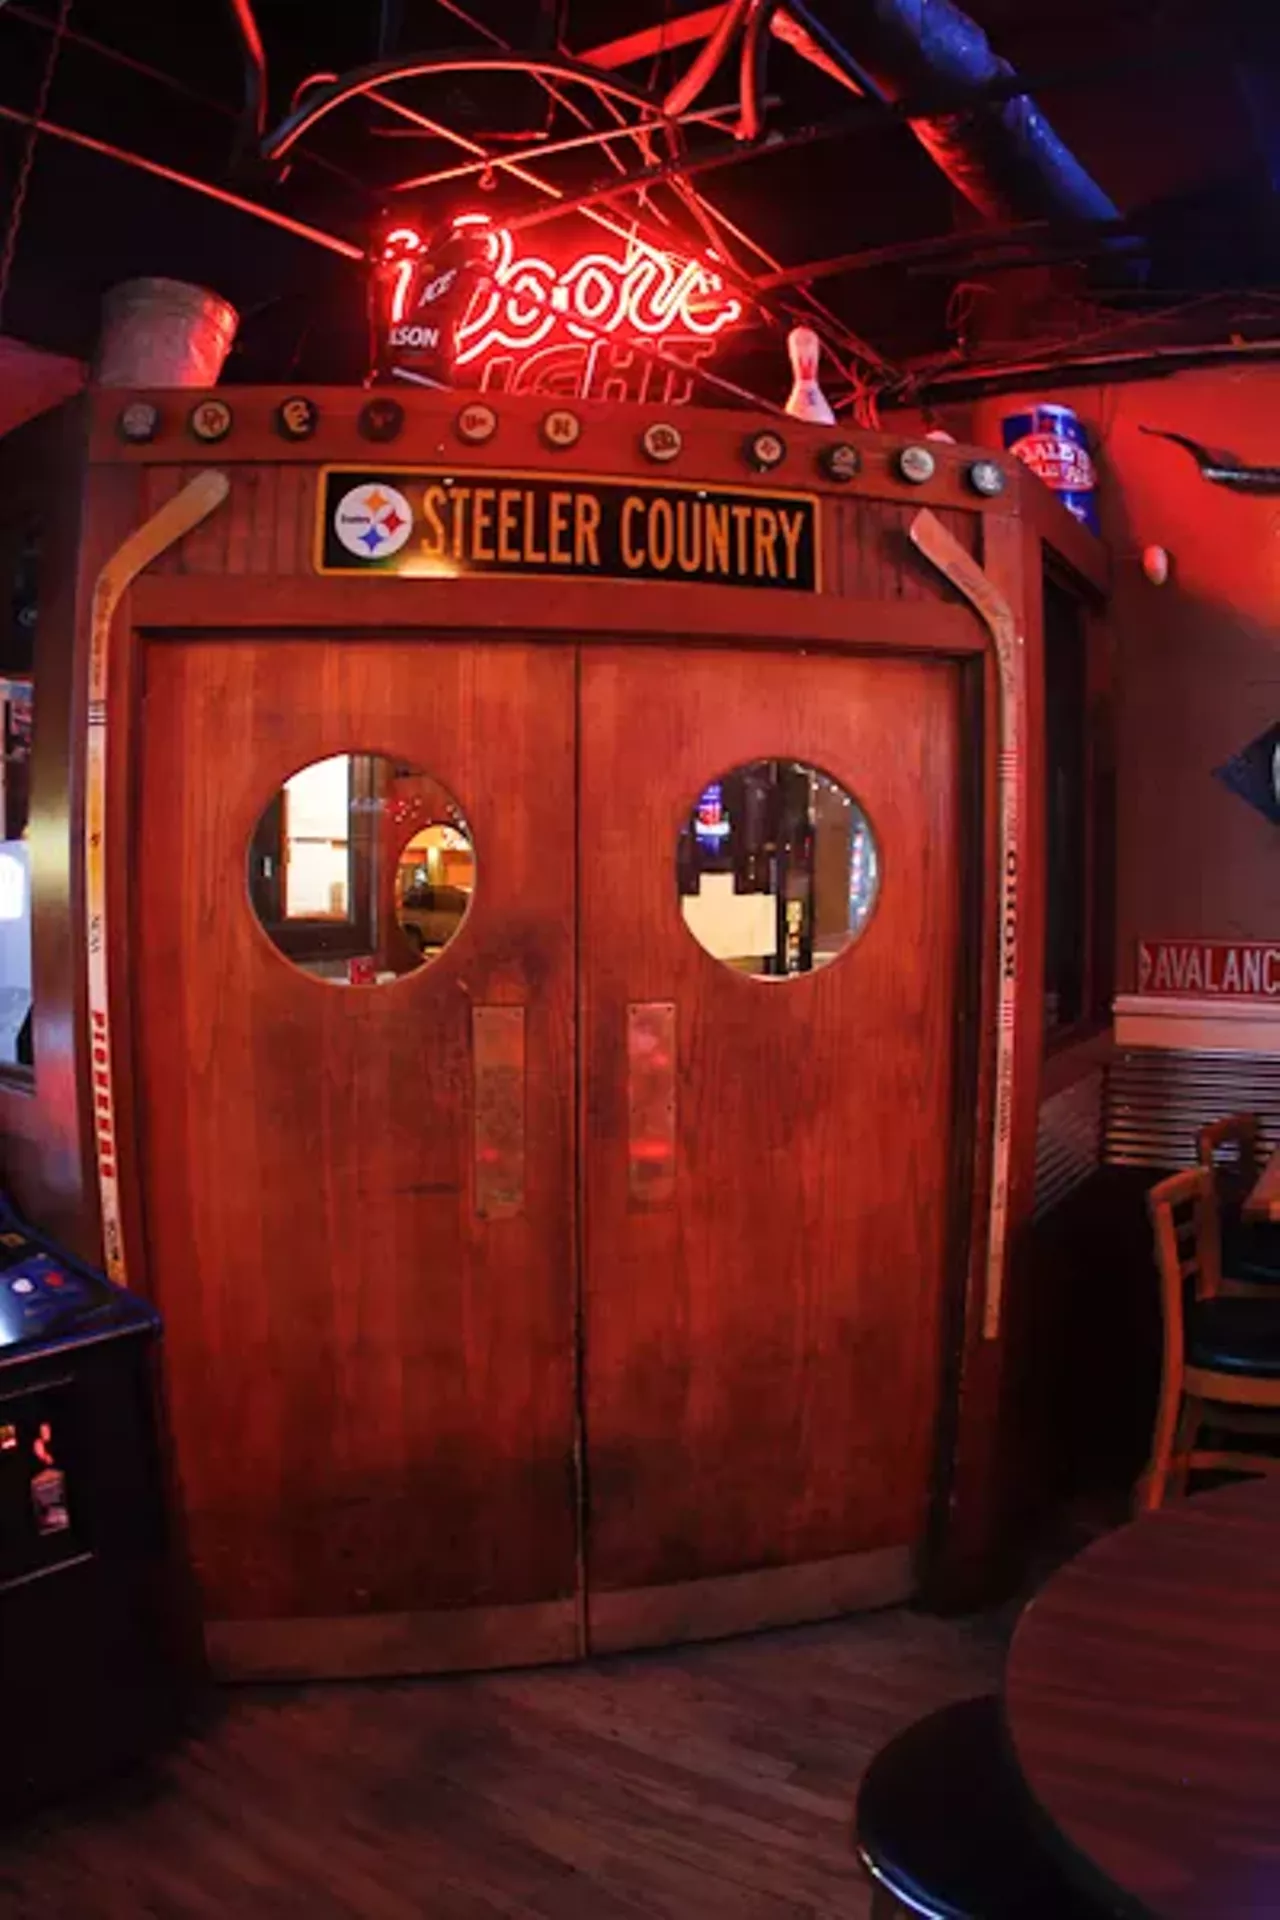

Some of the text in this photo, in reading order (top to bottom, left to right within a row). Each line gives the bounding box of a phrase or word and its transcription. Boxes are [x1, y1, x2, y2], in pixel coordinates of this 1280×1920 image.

[421, 485, 804, 580] STEELER COUNTRY
[1153, 944, 1280, 995] AVALANC
